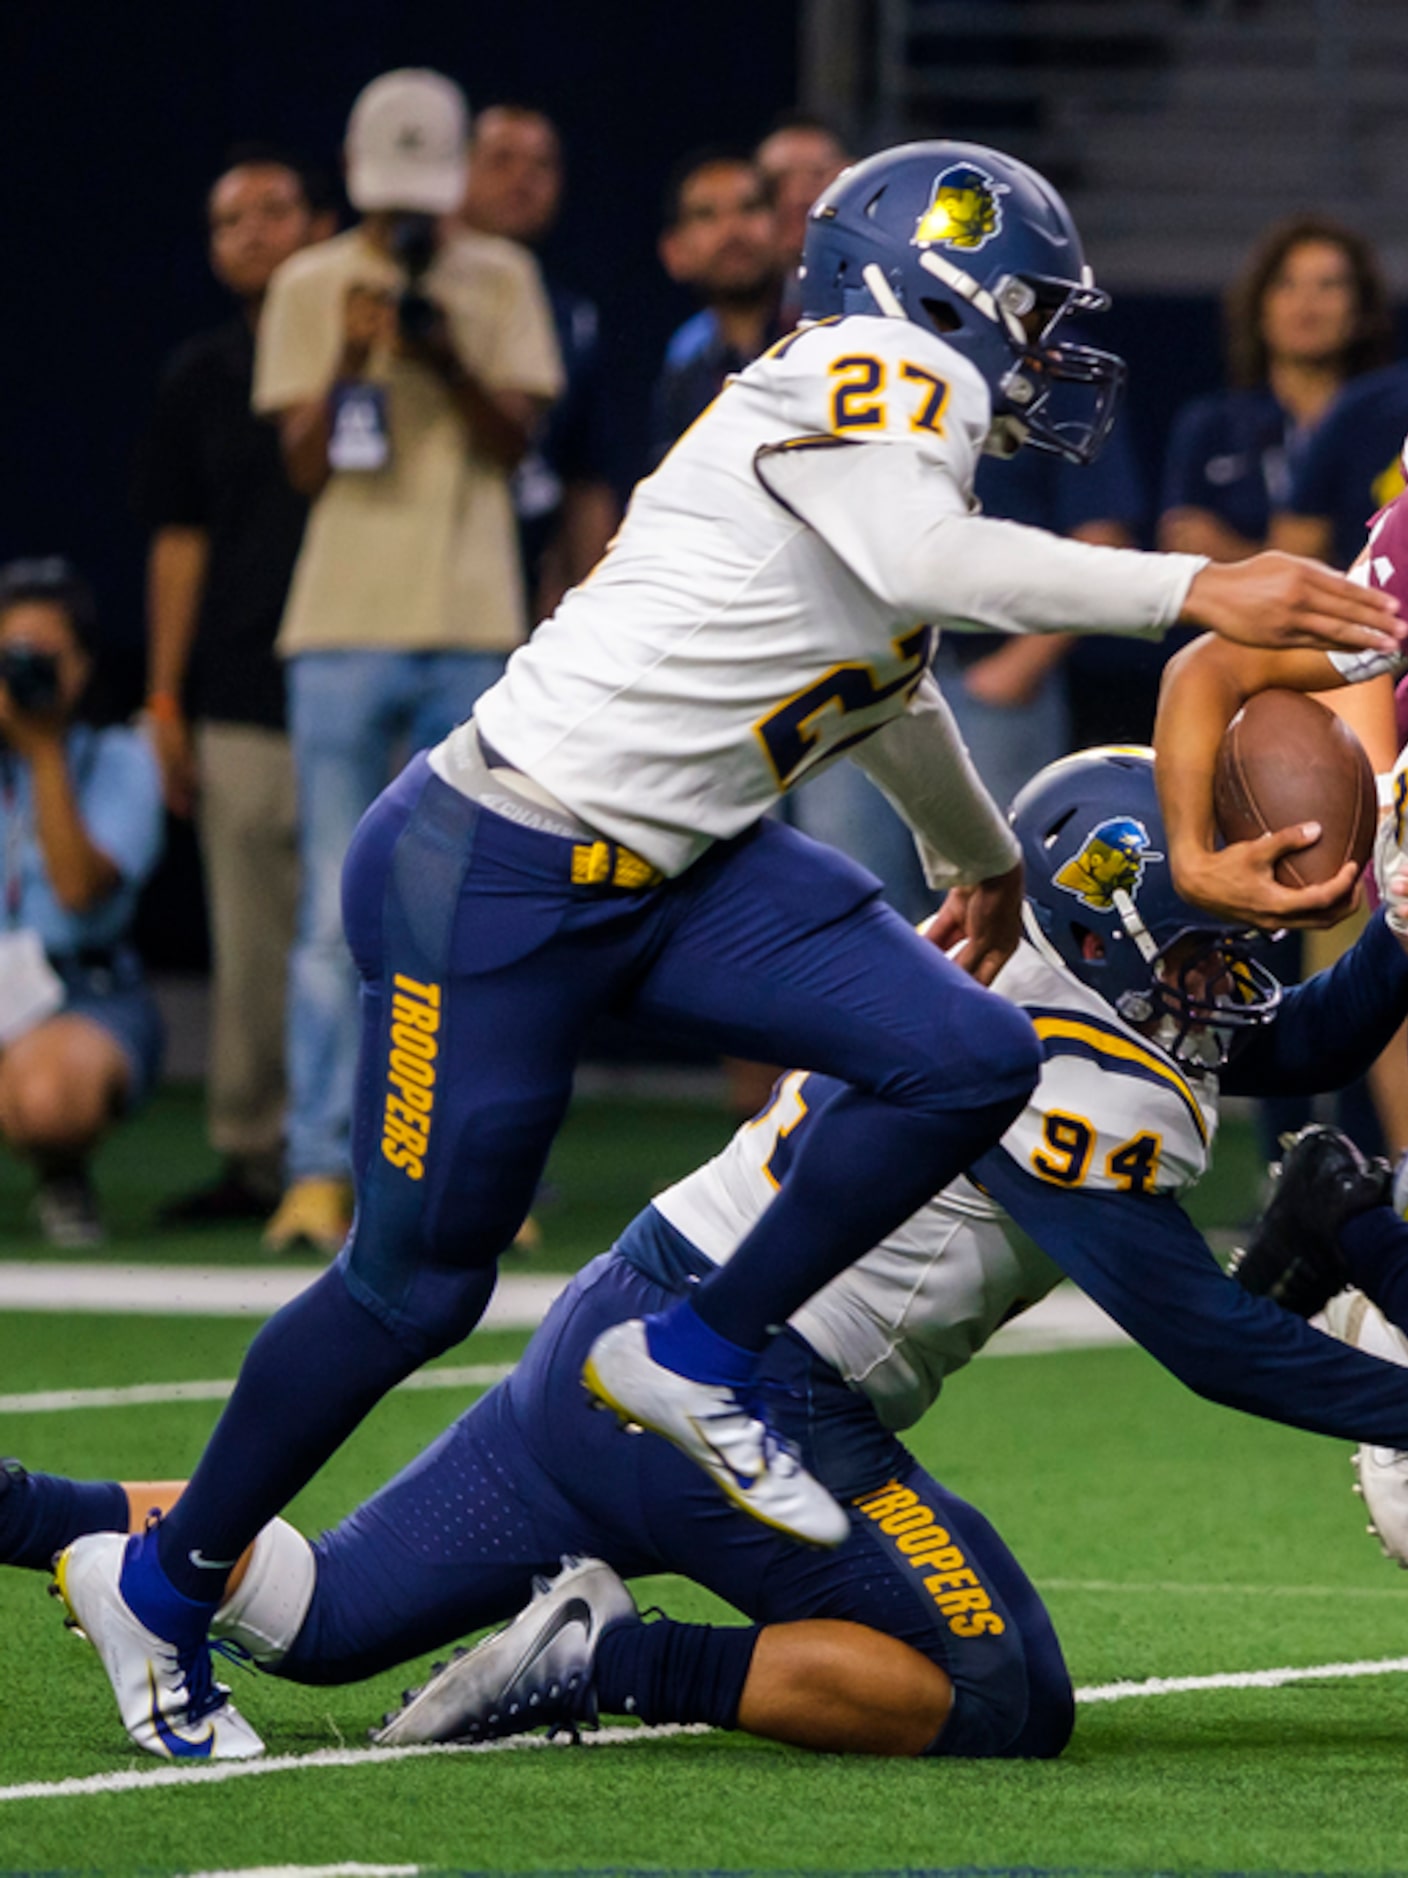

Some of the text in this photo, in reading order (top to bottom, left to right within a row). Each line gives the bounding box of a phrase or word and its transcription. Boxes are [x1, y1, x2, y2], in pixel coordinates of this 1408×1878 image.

[827, 352, 953, 440] 27
[381, 973, 441, 1180] TROOPERS
[1029, 1107, 1163, 1196] 94
[852, 1478, 1006, 1638] TROOPERS
